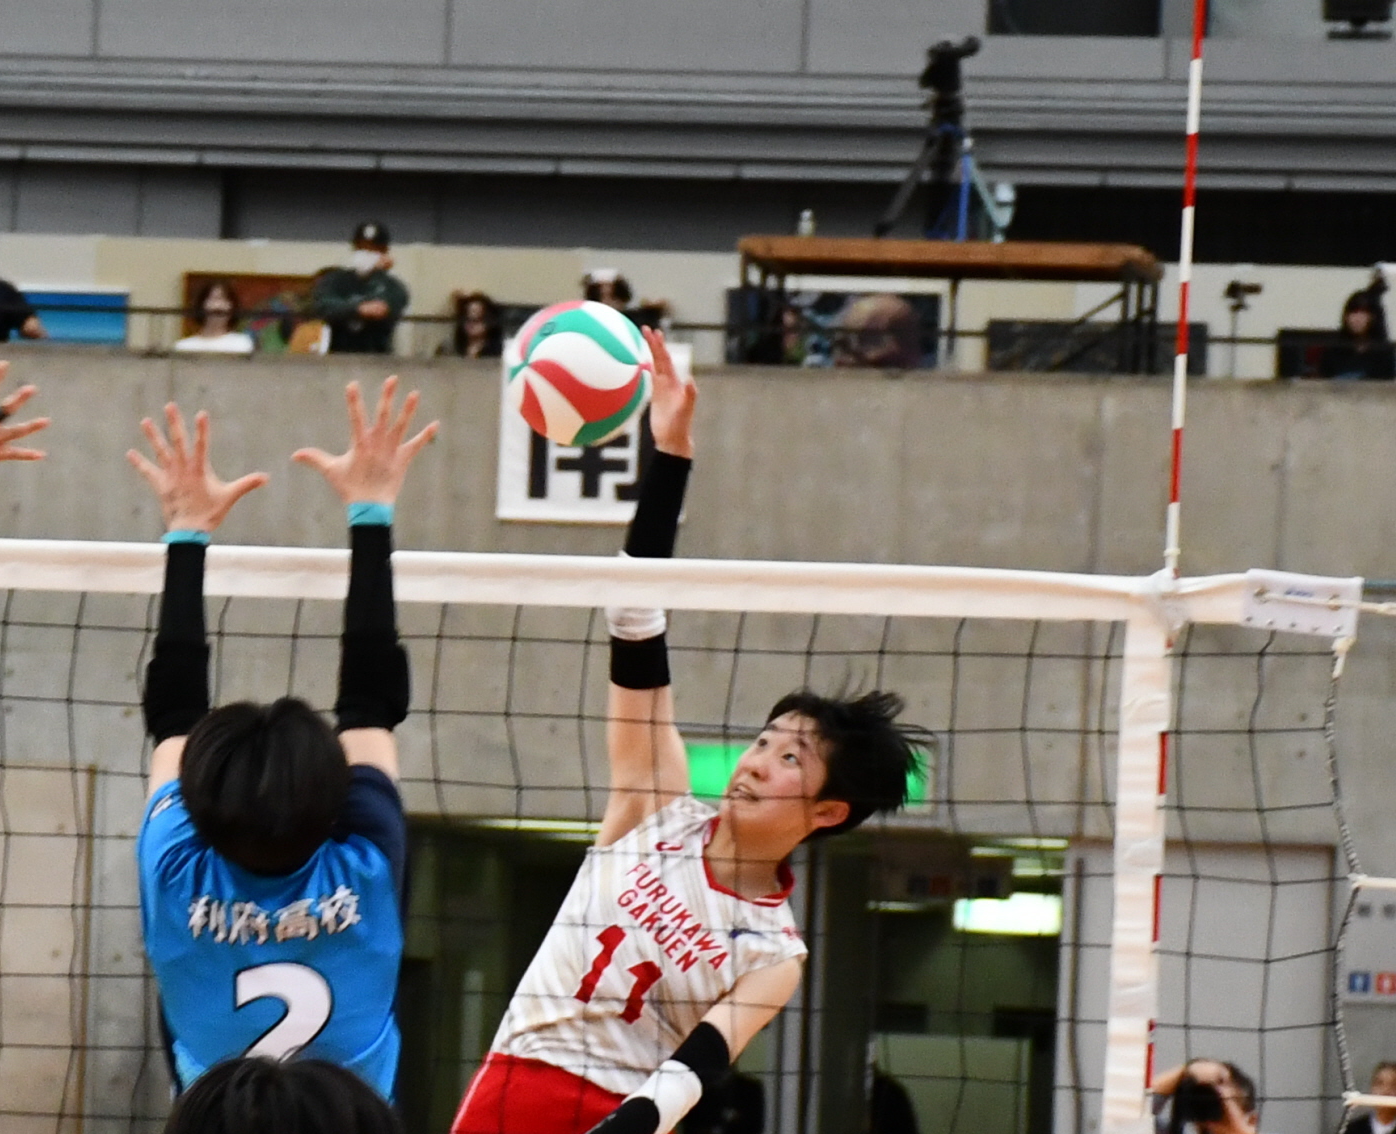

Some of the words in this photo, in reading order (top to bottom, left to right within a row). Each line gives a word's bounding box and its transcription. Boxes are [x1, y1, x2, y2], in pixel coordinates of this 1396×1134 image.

[187, 884, 362, 945] 利府高校
[617, 888, 699, 973] GAKUEN
[625, 862, 729, 971] FURUKAWA
[233, 961, 332, 1064] 2
[573, 924, 663, 1025] 11
